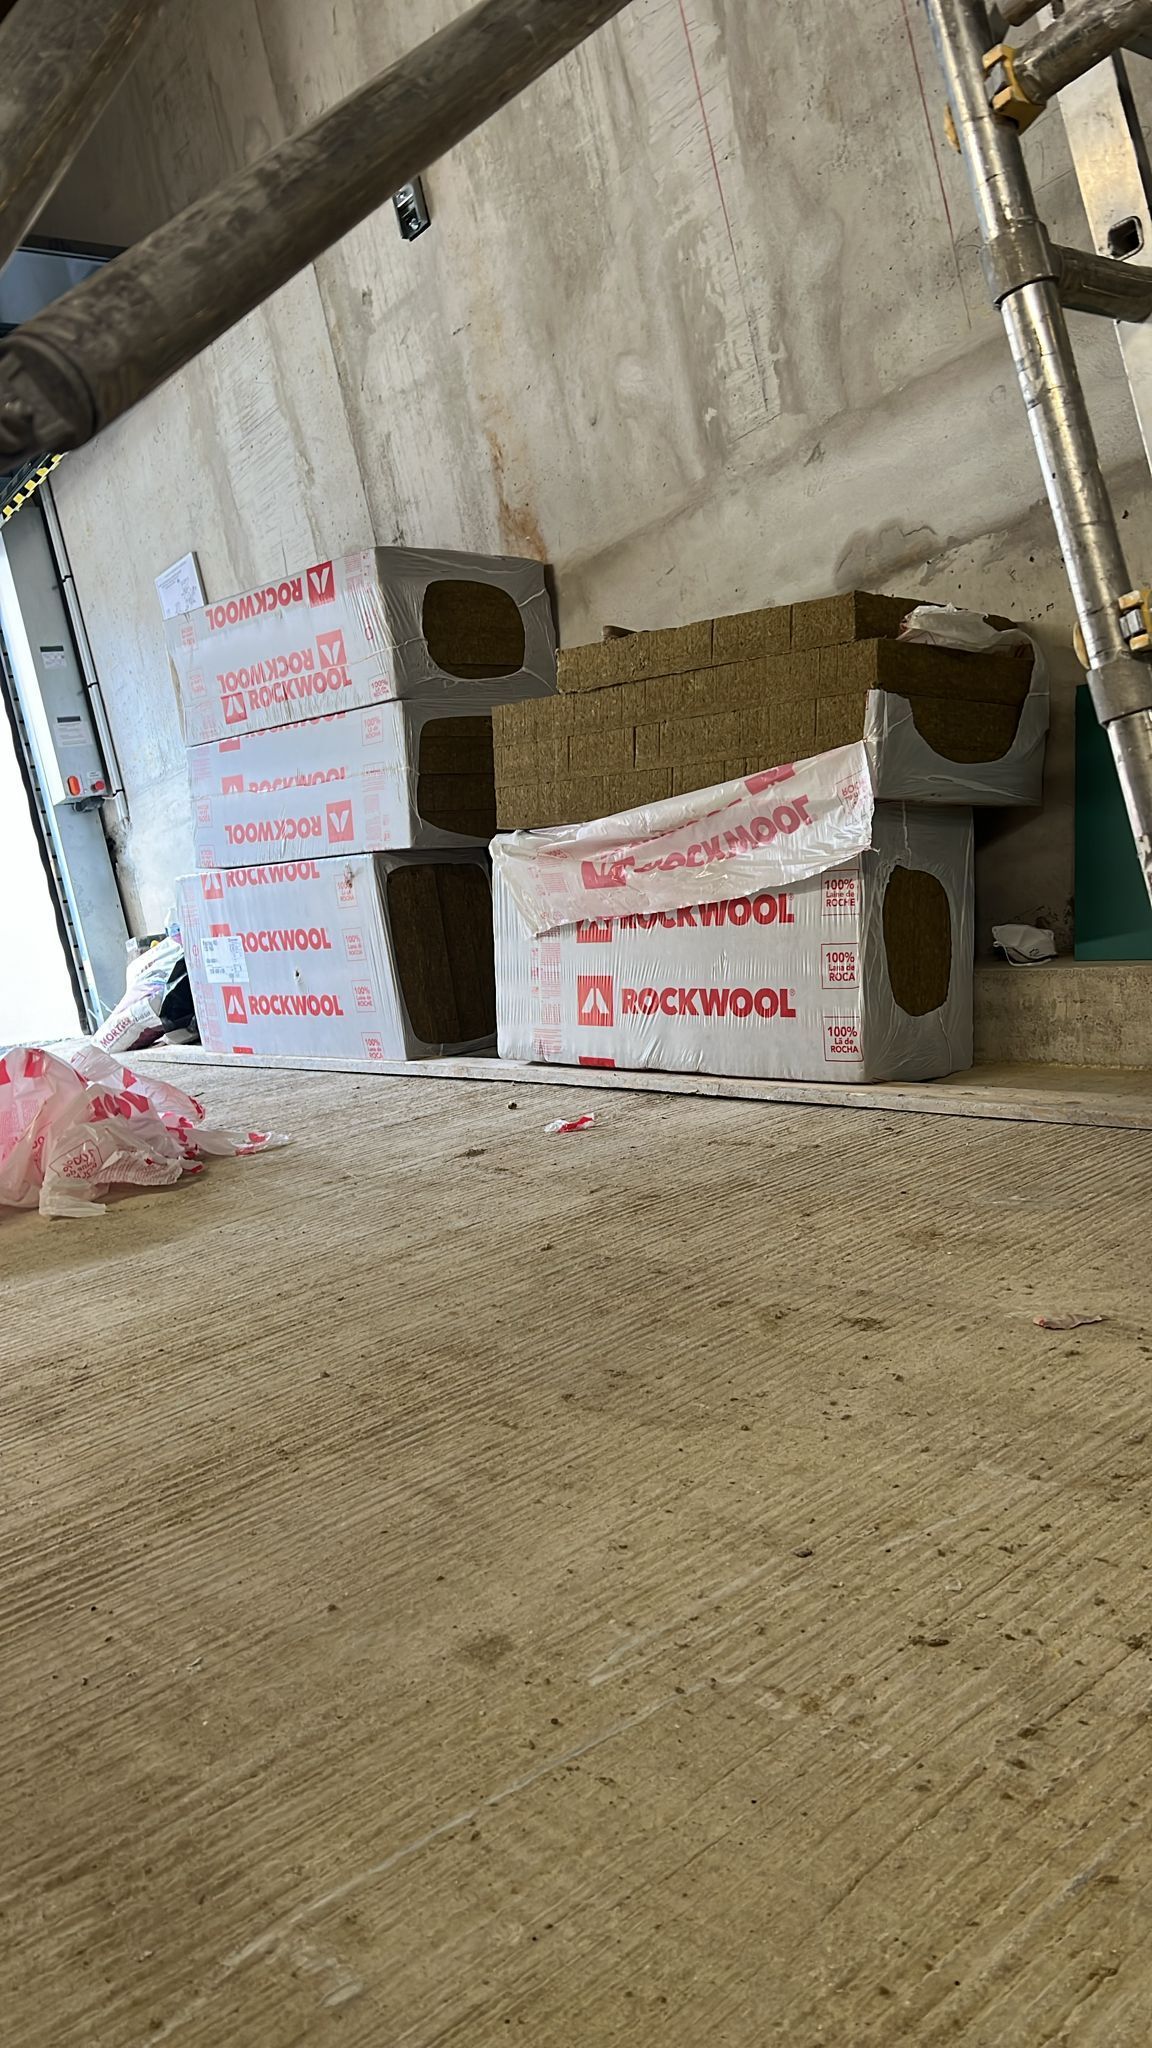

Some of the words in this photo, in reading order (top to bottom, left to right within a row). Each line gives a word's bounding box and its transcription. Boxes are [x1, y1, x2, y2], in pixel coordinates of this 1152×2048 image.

[206, 577, 303, 631] ROCKWOOL
[217, 648, 315, 694] ROCKWOOL
[248, 668, 353, 711] ROCKWOOL
[225, 816, 322, 845] ROCKWOOL
[226, 862, 320, 888] ROCKWOOL
[824, 879, 855, 890] 100%
[826, 898, 856, 907] ROCHE
[826, 952, 855, 963] 100%
[829, 973, 856, 981] ROCA
[248, 995, 344, 1016] ROCKWOOL
[828, 1027, 858, 1037] 100%
